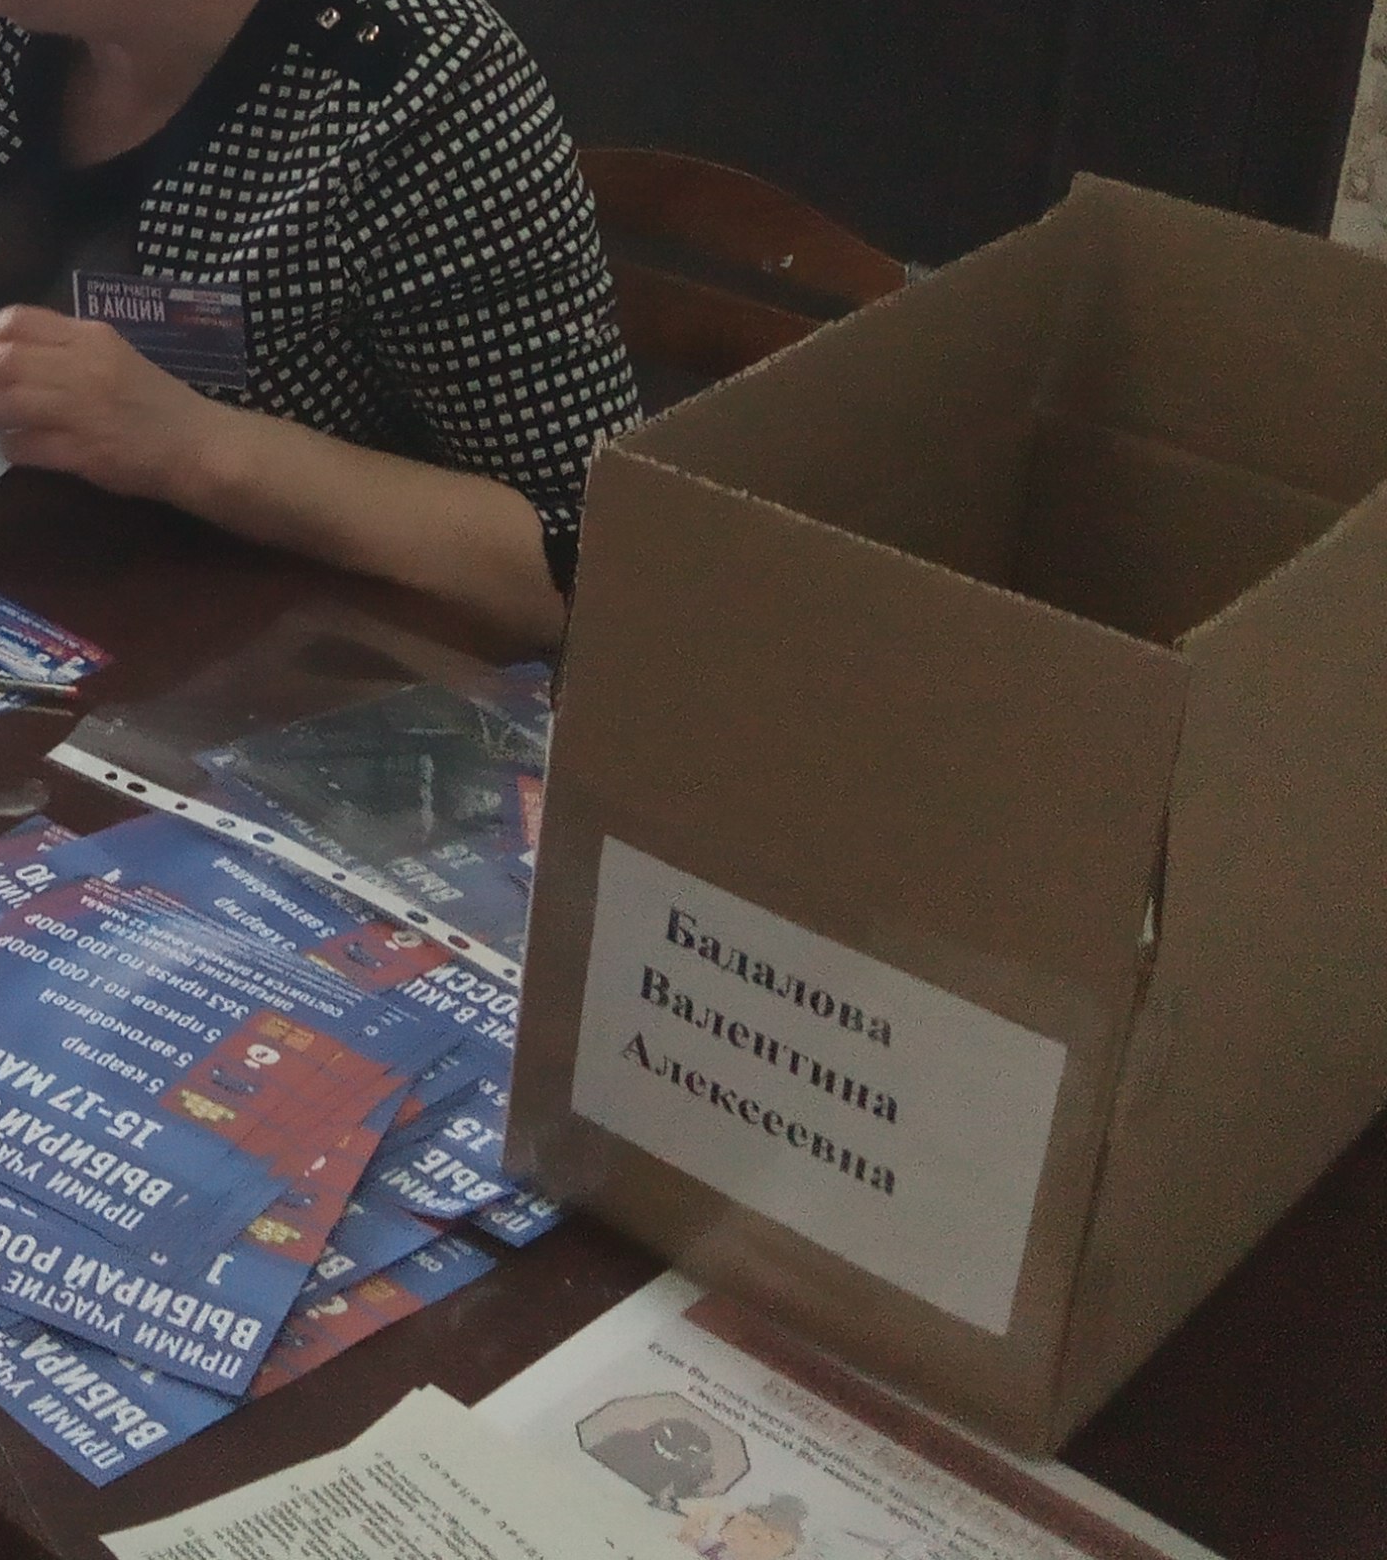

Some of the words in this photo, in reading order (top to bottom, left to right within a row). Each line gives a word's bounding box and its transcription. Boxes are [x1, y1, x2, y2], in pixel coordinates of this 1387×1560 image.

[87, 294, 99, 316] В
[103, 297, 165, 323] АКЦИИ
[103, 981, 131, 1000] по
[396, 977, 461, 1012] АКЦ
[424, 965, 521, 1023] ОССИ
[666, 905, 893, 1048] Бадалова
[38, 989, 178, 1057] автомобилей
[131, 994, 206, 1033] призов
[641, 964, 899, 1125] Валентина
[61, 1036, 148, 1084] квартир
[47, 1085, 164, 1150] 15-17
[622, 1030, 896, 1198] Алексеевна
[45, 1170, 145, 1231] ПРИМИ
[1, 1269, 125, 1337] УЧАСТИЕ
[63, 1254, 262, 1351] ВЫБИРАЙ
[133, 1321, 243, 1380] ПРИМИ
[27, 1393, 125, 1470] ПРИМИ
